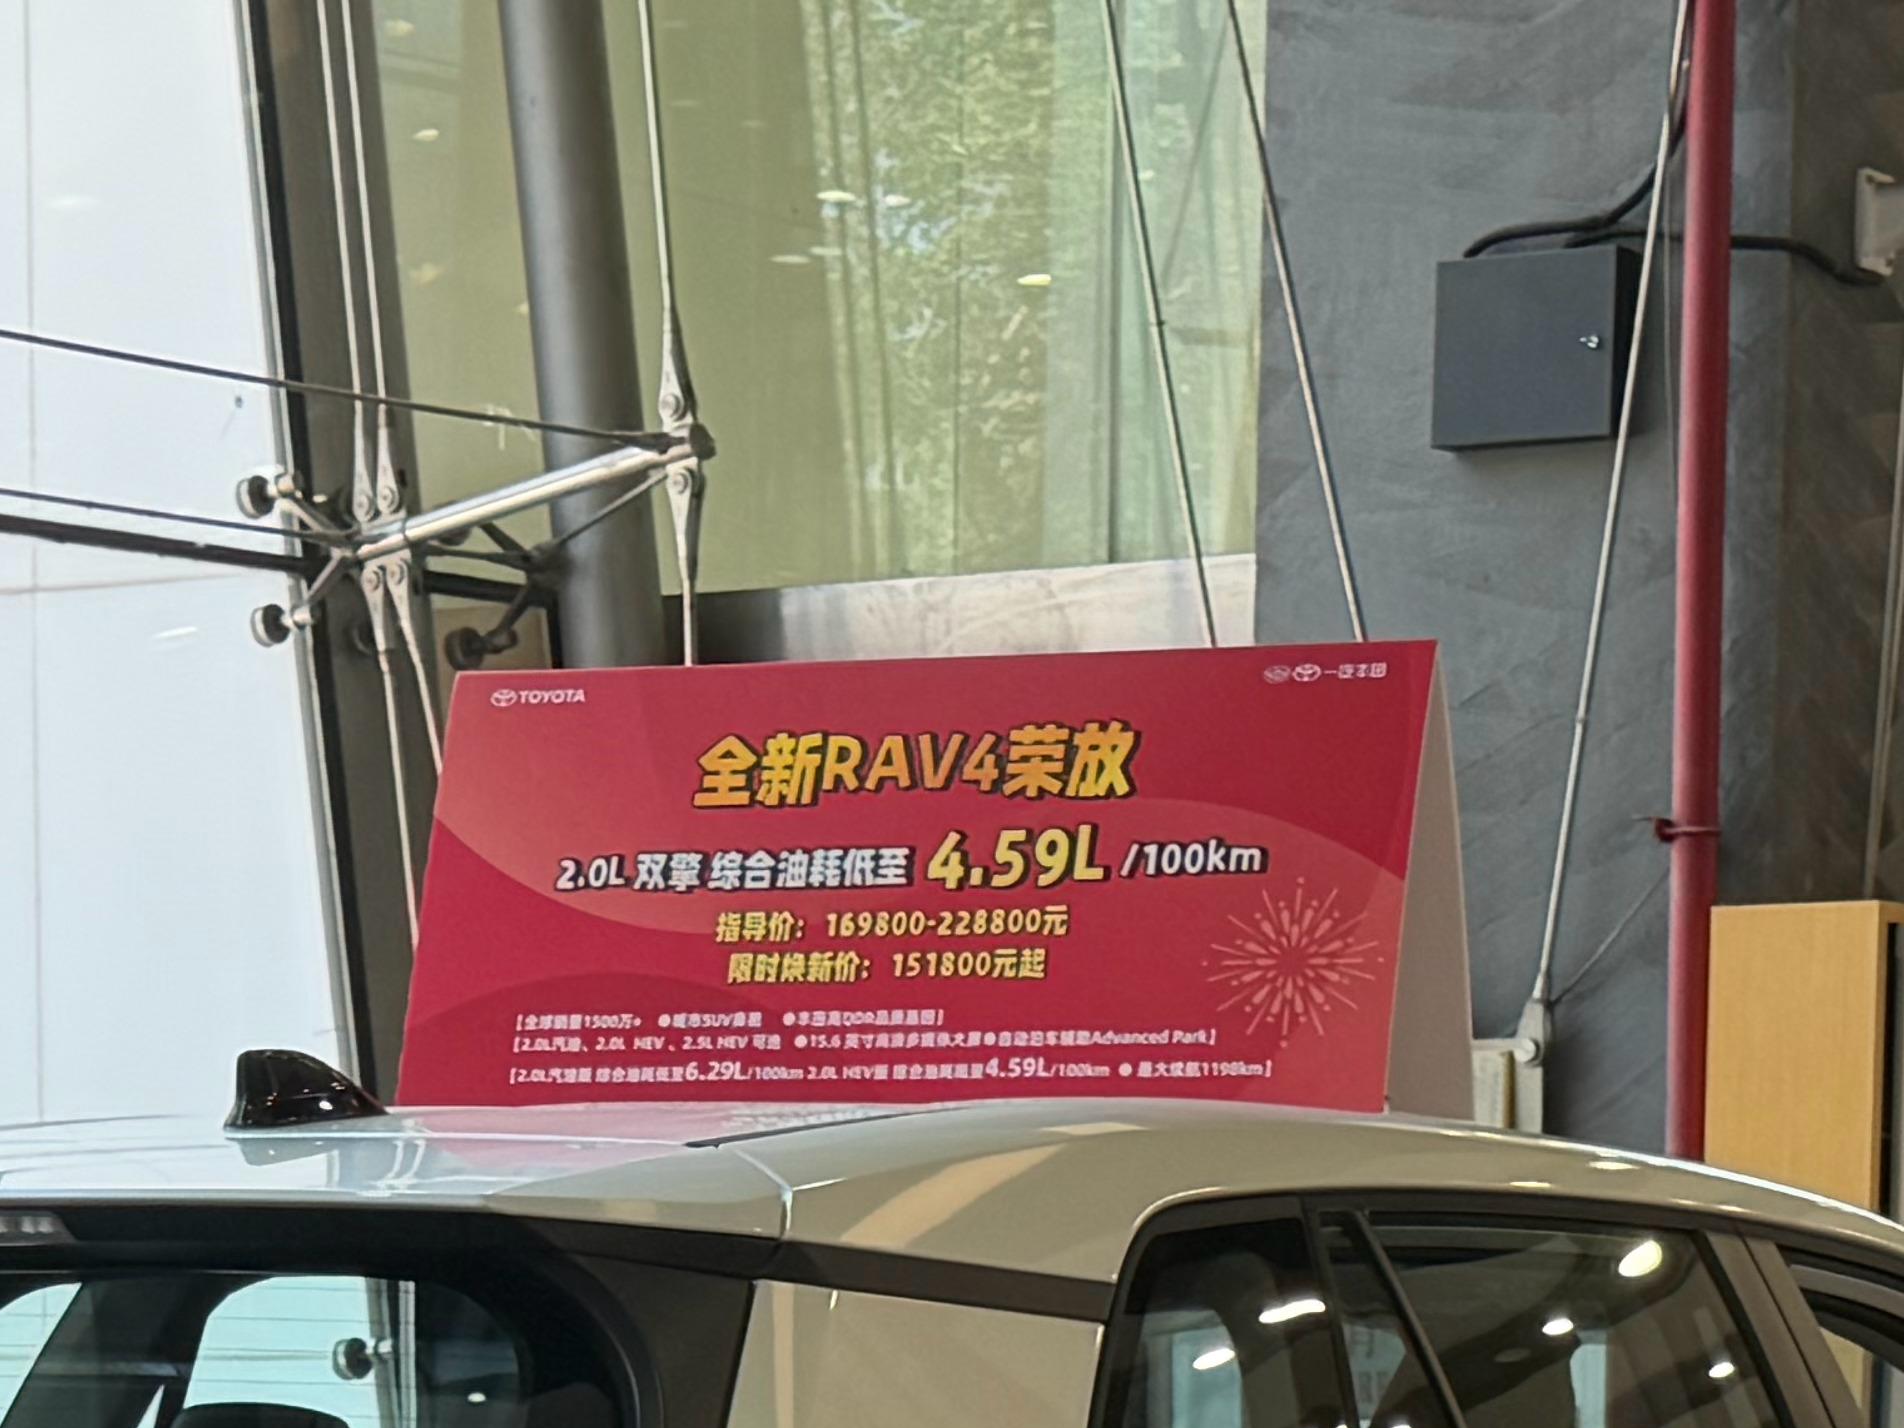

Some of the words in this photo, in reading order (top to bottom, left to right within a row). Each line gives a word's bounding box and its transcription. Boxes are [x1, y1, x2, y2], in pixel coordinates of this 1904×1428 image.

[518, 688, 586, 704] TOYOTA
[692, 719, 1139, 808] 全新RAV4荣放
[555, 857, 627, 891] 2.0L
[633, 851, 704, 892] 双擎
[707, 847, 911, 891] 综合油耗低至
[925, 823, 1109, 890] 4.59L
[1119, 837, 1267, 879] /100km
[715, 910, 806, 943] 指导价：
[826, 904, 1070, 939] 169800-228800元
[892, 947, 1048, 980] 151800元起
